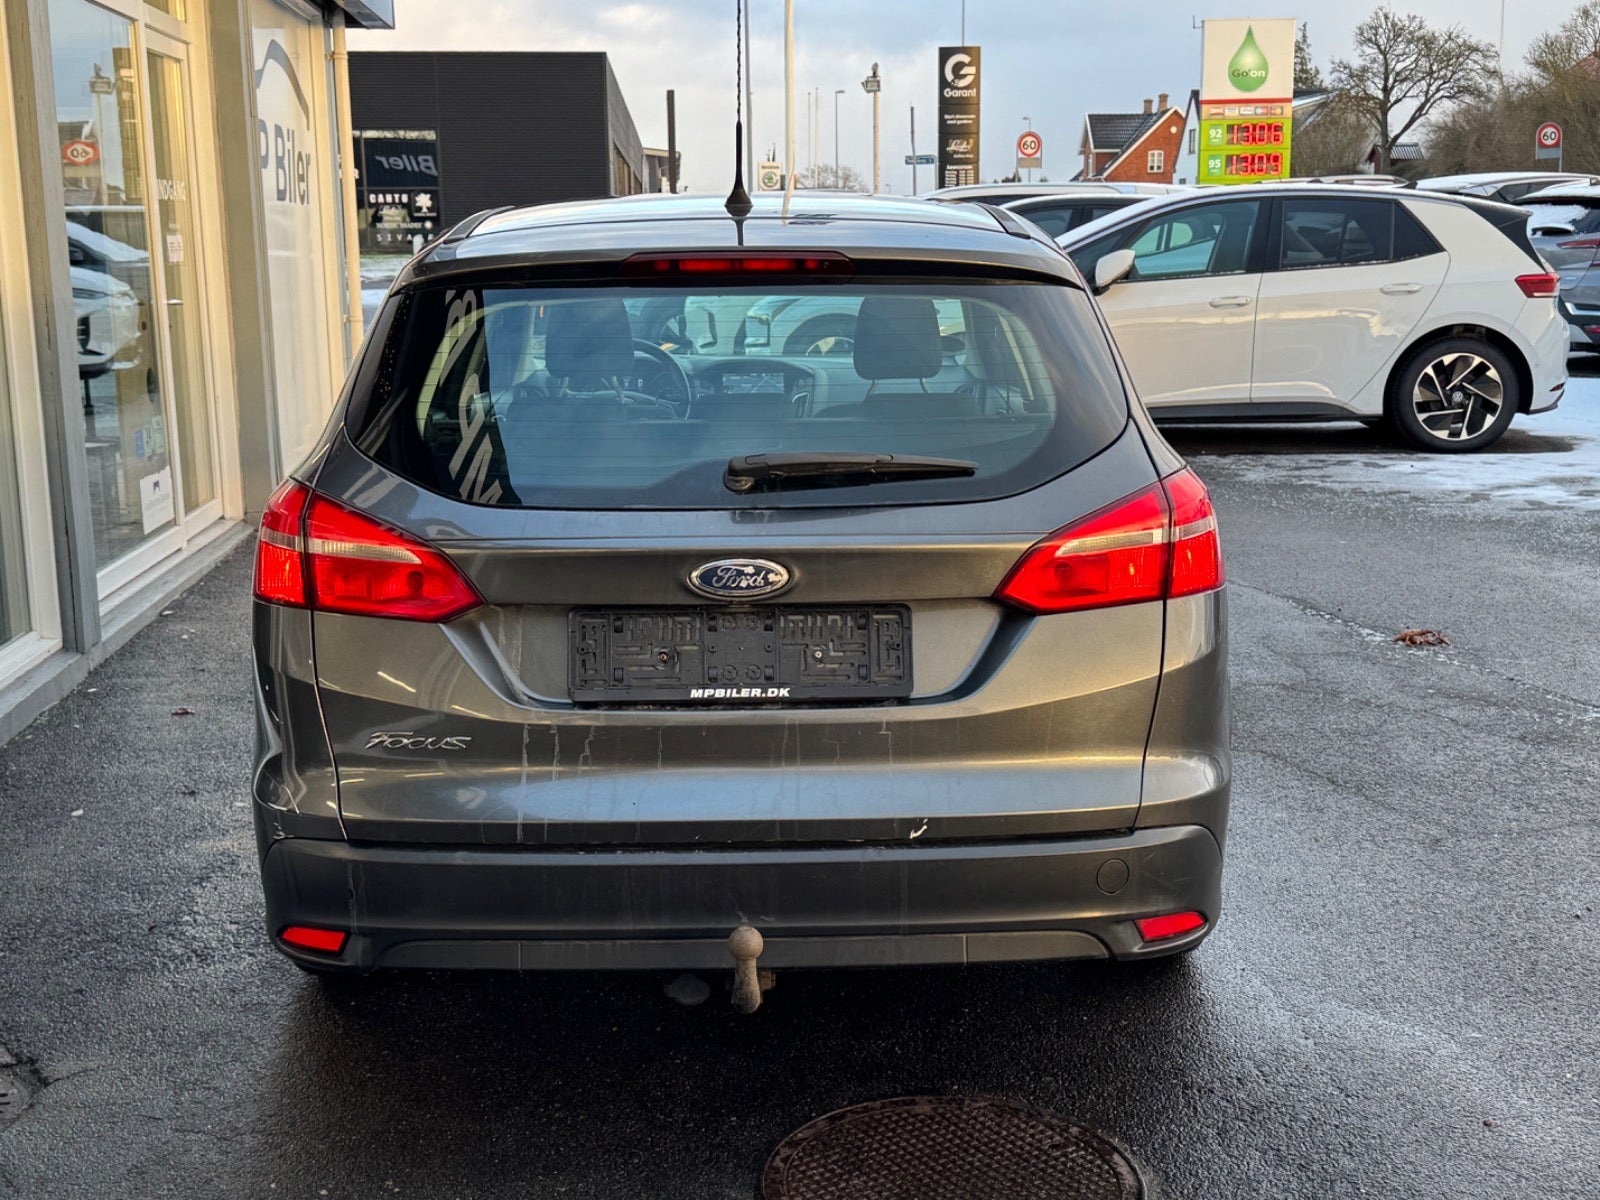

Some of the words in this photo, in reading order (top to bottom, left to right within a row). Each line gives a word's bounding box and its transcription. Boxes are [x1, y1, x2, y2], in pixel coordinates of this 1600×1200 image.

[944, 87, 977, 97] Garant
[1209, 129, 1222, 138] 92
[1542, 131, 1557, 141] 60
[1022, 140, 1037, 150] 60
[257, 118, 269, 170] P
[274, 123, 311, 206] Biler
[1208, 159, 1221, 168] 95
[712, 565, 766, 587] Ford
[690, 687, 790, 698] MPBILER.DK
